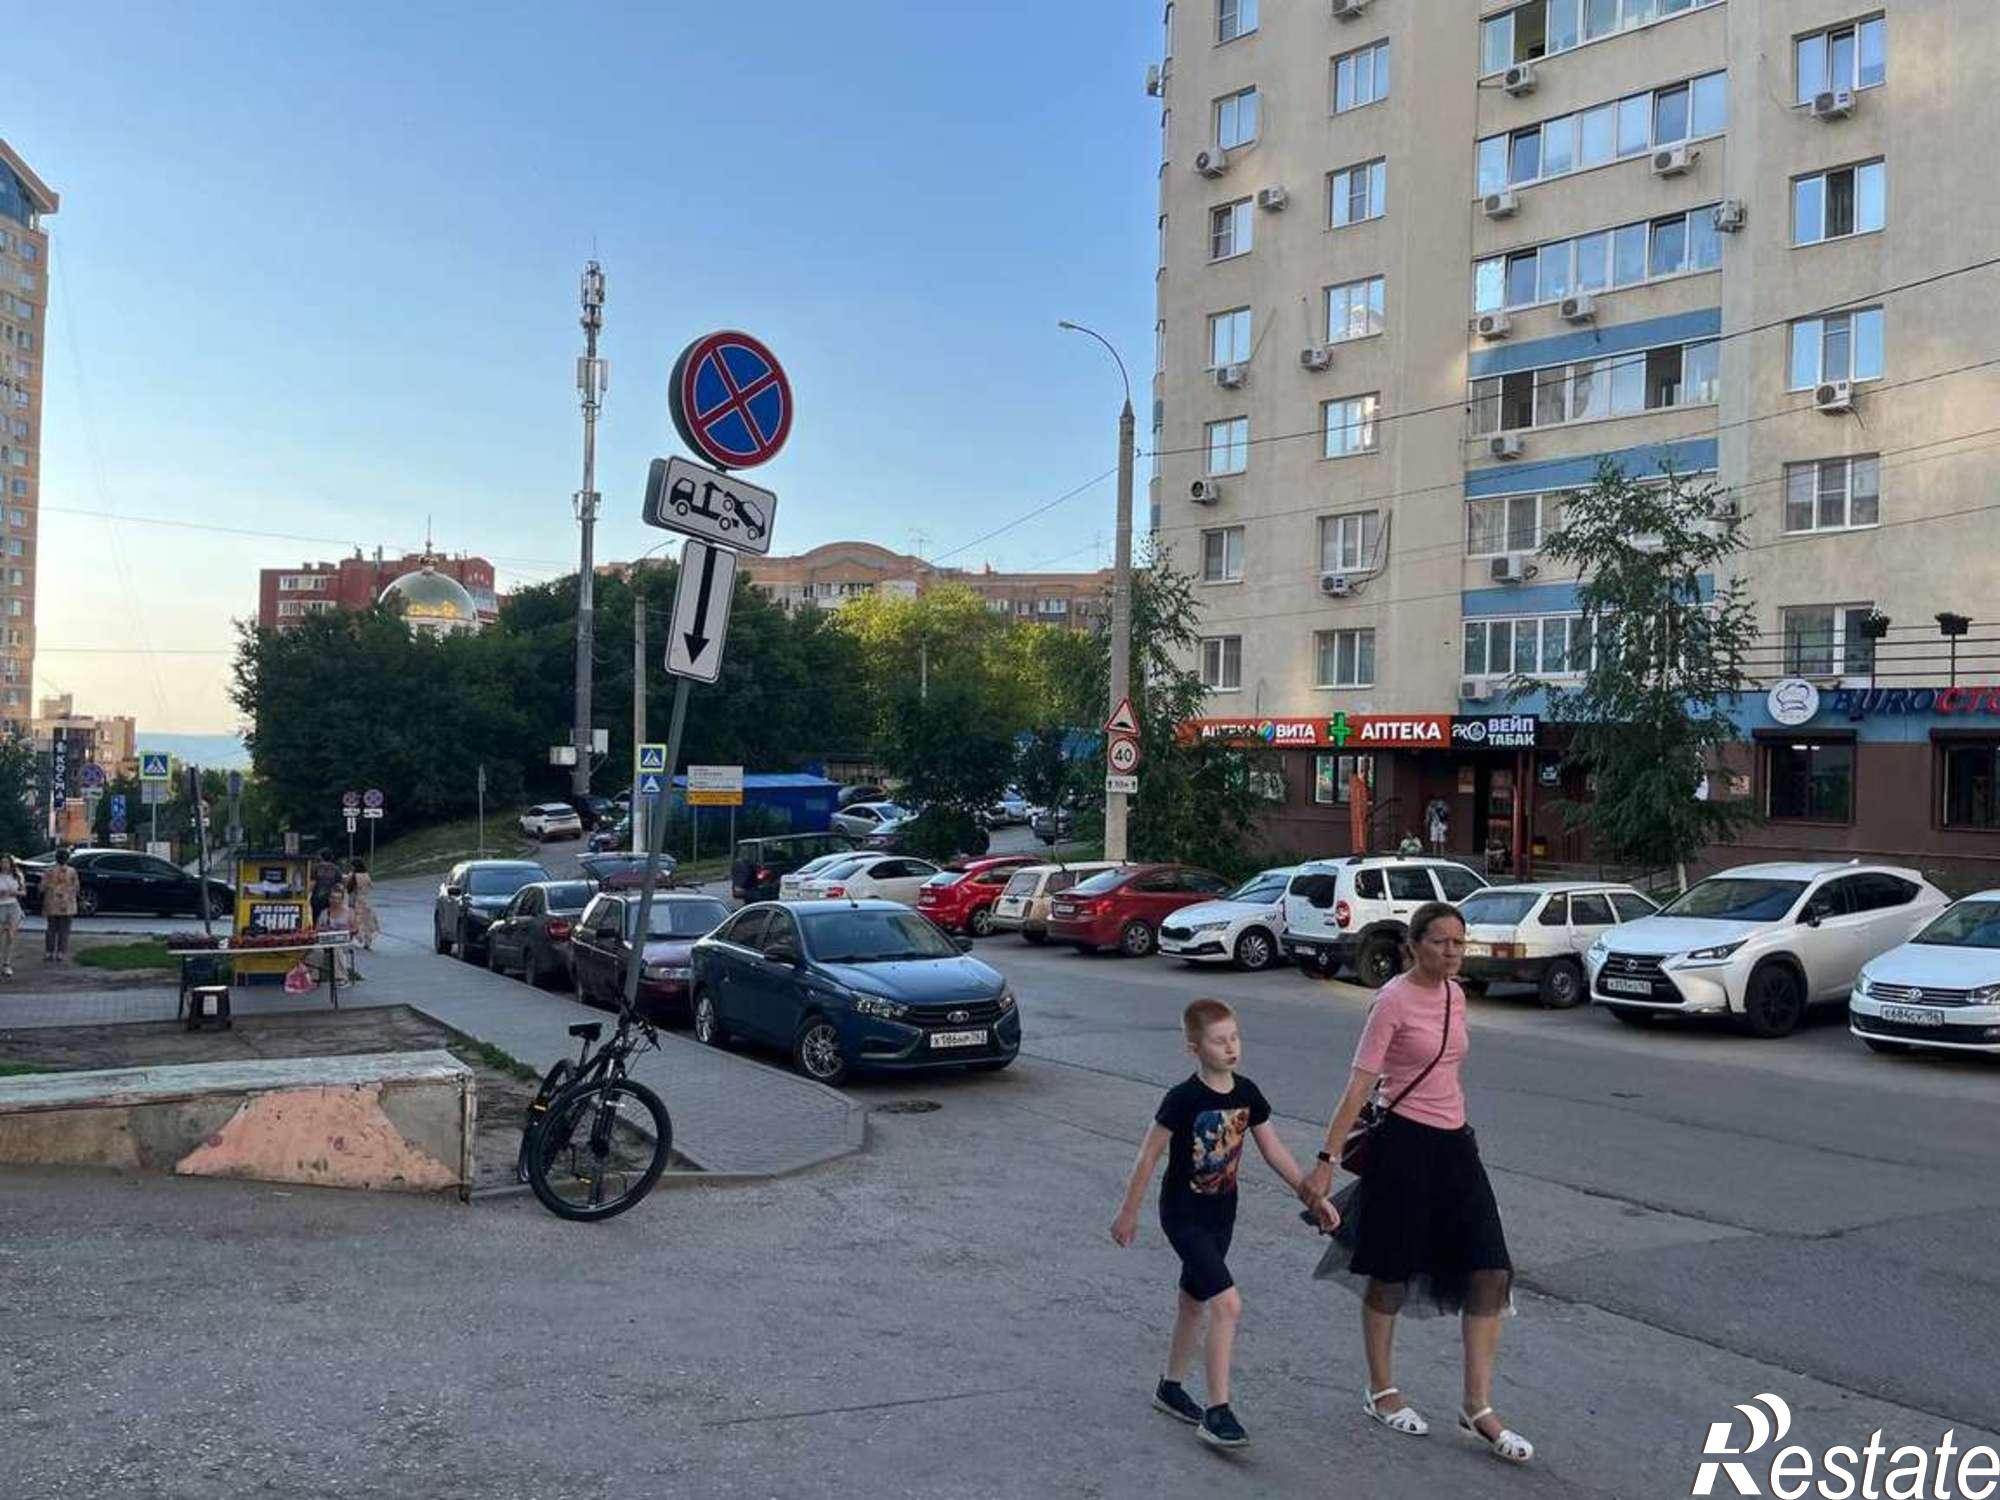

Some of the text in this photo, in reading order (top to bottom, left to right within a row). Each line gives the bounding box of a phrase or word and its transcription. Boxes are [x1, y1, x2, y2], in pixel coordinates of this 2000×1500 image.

[1275, 724, 1316, 737] ВИТА
[1360, 721, 1441, 740] АПТЕКА
[1487, 716, 1534, 733] ВЕЙП
[1487, 733, 1535, 746] ТАБАК
[1114, 748, 1133, 762] 40
